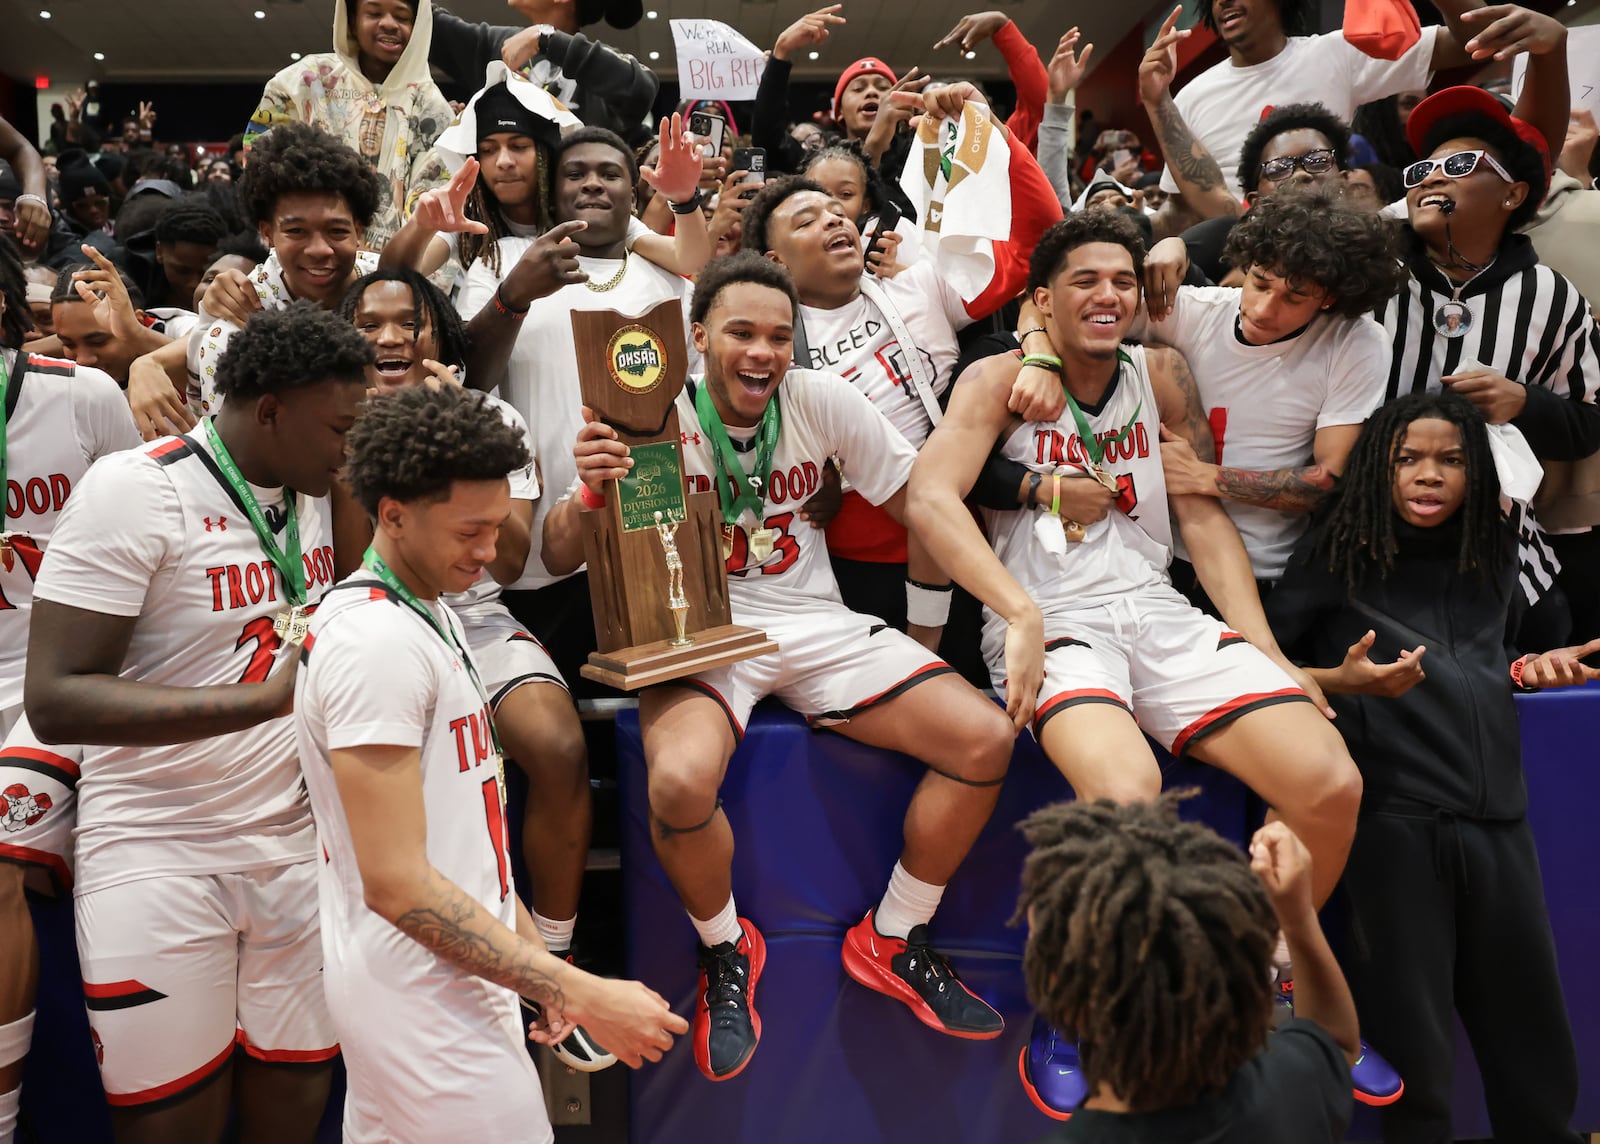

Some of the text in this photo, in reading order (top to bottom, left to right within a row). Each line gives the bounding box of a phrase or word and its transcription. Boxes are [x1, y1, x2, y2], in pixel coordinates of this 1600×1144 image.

[678, 22, 716, 39] We're
[706, 40, 736, 54] REAL
[689, 58, 724, 90] BIG
[809, 320, 881, 370] BLEED
[618, 350, 657, 368] OHSAA
[635, 482, 666, 498] 2026
[227, 466, 240, 483] SCHOOL
[239, 484, 254, 505] ATHLETIC
[252, 506, 269, 533] ASSOCIATION
[623, 496, 681, 513] DIVISION III
[206, 546, 335, 612] TROTOOD
